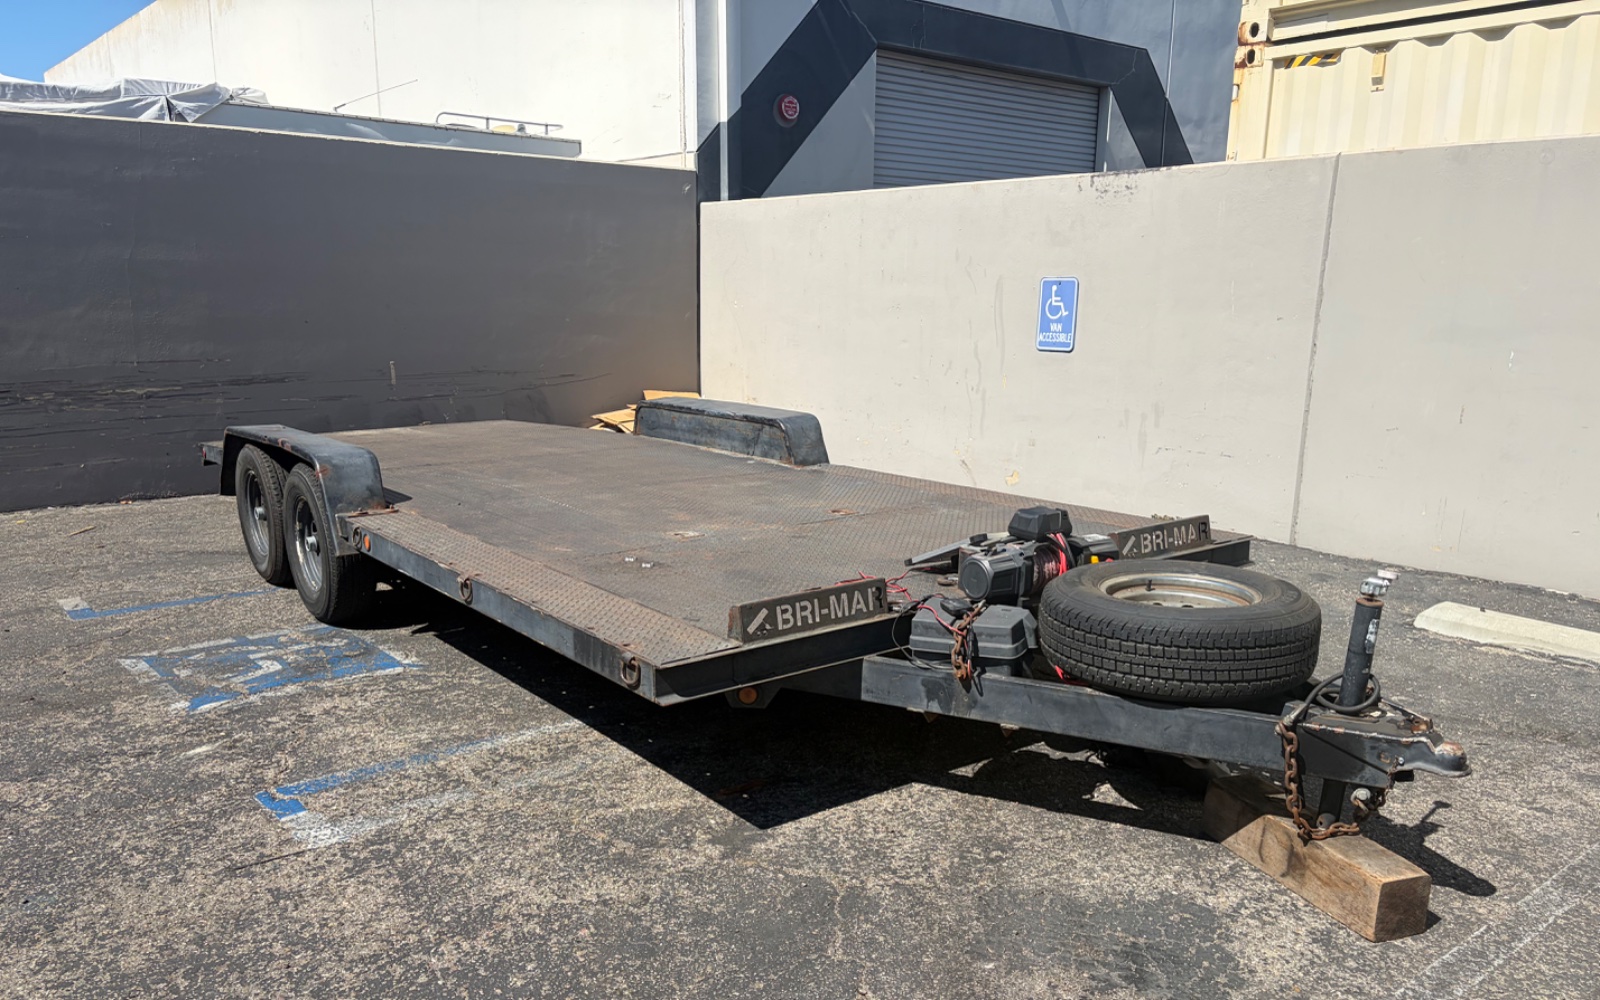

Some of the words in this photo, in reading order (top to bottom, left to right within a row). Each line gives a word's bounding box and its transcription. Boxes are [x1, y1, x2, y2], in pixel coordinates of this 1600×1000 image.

[1040, 332, 1072, 342] ACCESSIBLE
[1050, 322, 1062, 332] VAN
[1140, 522, 1208, 553] BRI-MAR
[776, 586, 884, 630] BRI-MAR
